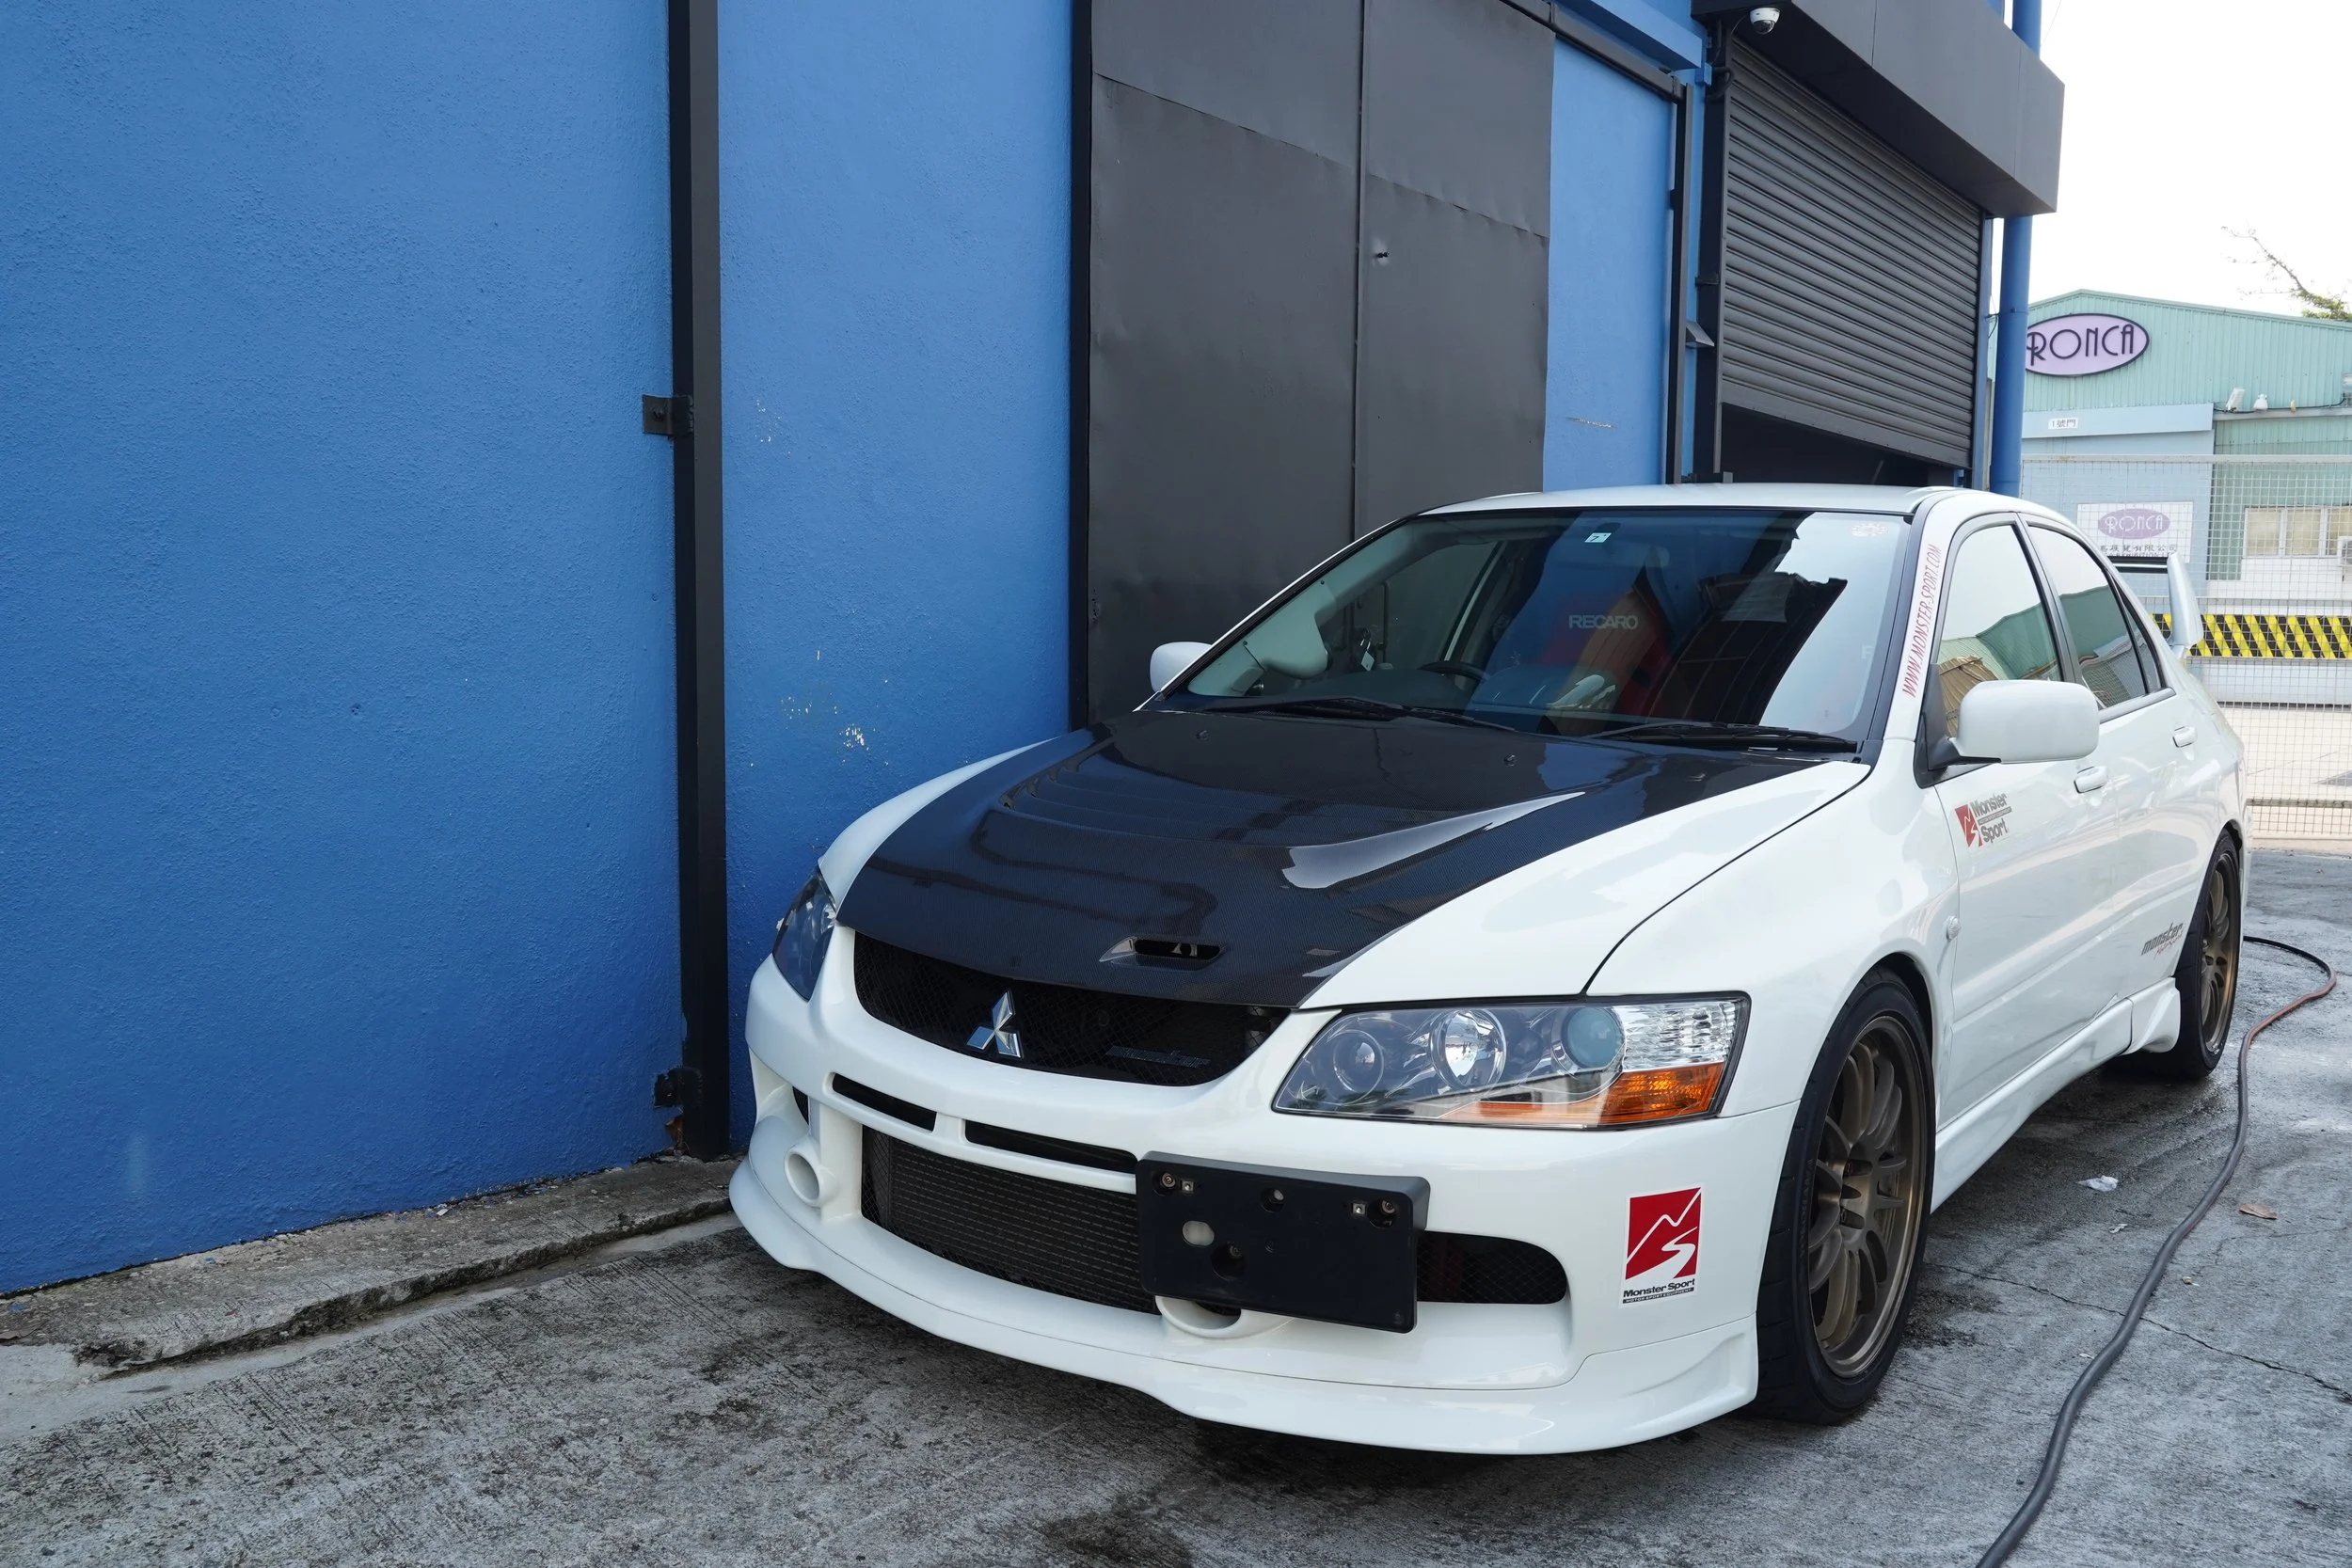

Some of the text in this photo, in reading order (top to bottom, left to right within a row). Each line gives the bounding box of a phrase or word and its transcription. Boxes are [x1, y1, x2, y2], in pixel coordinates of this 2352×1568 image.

[2027, 324, 2135, 366] RONCA
[2105, 515, 2163, 533] RONCA
[1568, 614, 1639, 629] RECARO
[1902, 544, 1942, 698] WWW.MONSTER-SPORT.COM
[1970, 793, 2007, 817] Monster
[1980, 817, 2009, 843] Sport
[1624, 1278, 1695, 1297] Monster Sport
